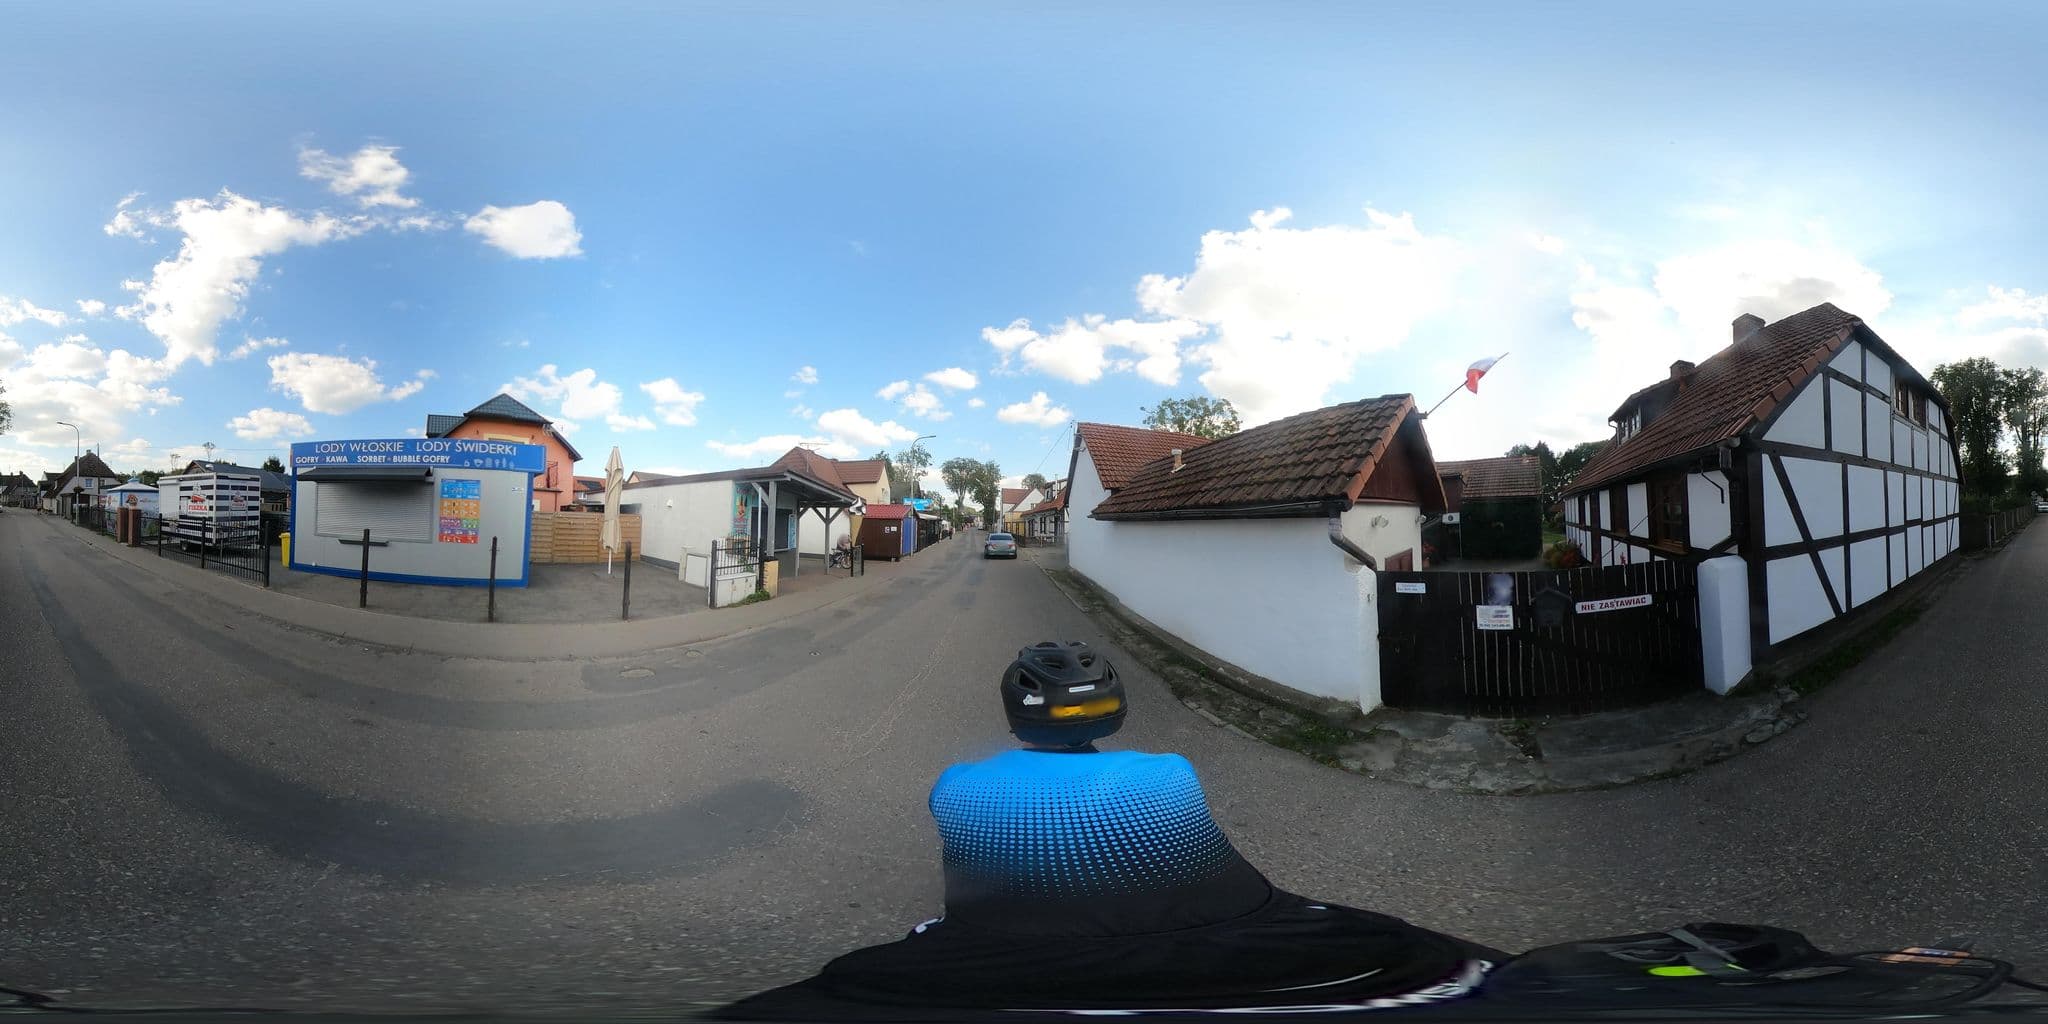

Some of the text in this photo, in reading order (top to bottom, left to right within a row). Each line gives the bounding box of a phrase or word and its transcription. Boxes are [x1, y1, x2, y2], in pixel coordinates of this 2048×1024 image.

[315, 440, 517, 456] LODY WŁOSKIE LODY ŚWIDERKI
[295, 455, 450, 464] GOFRY KAWA SORBET BUBBLE GOFRY
[1581, 603, 1596, 612] NIE
